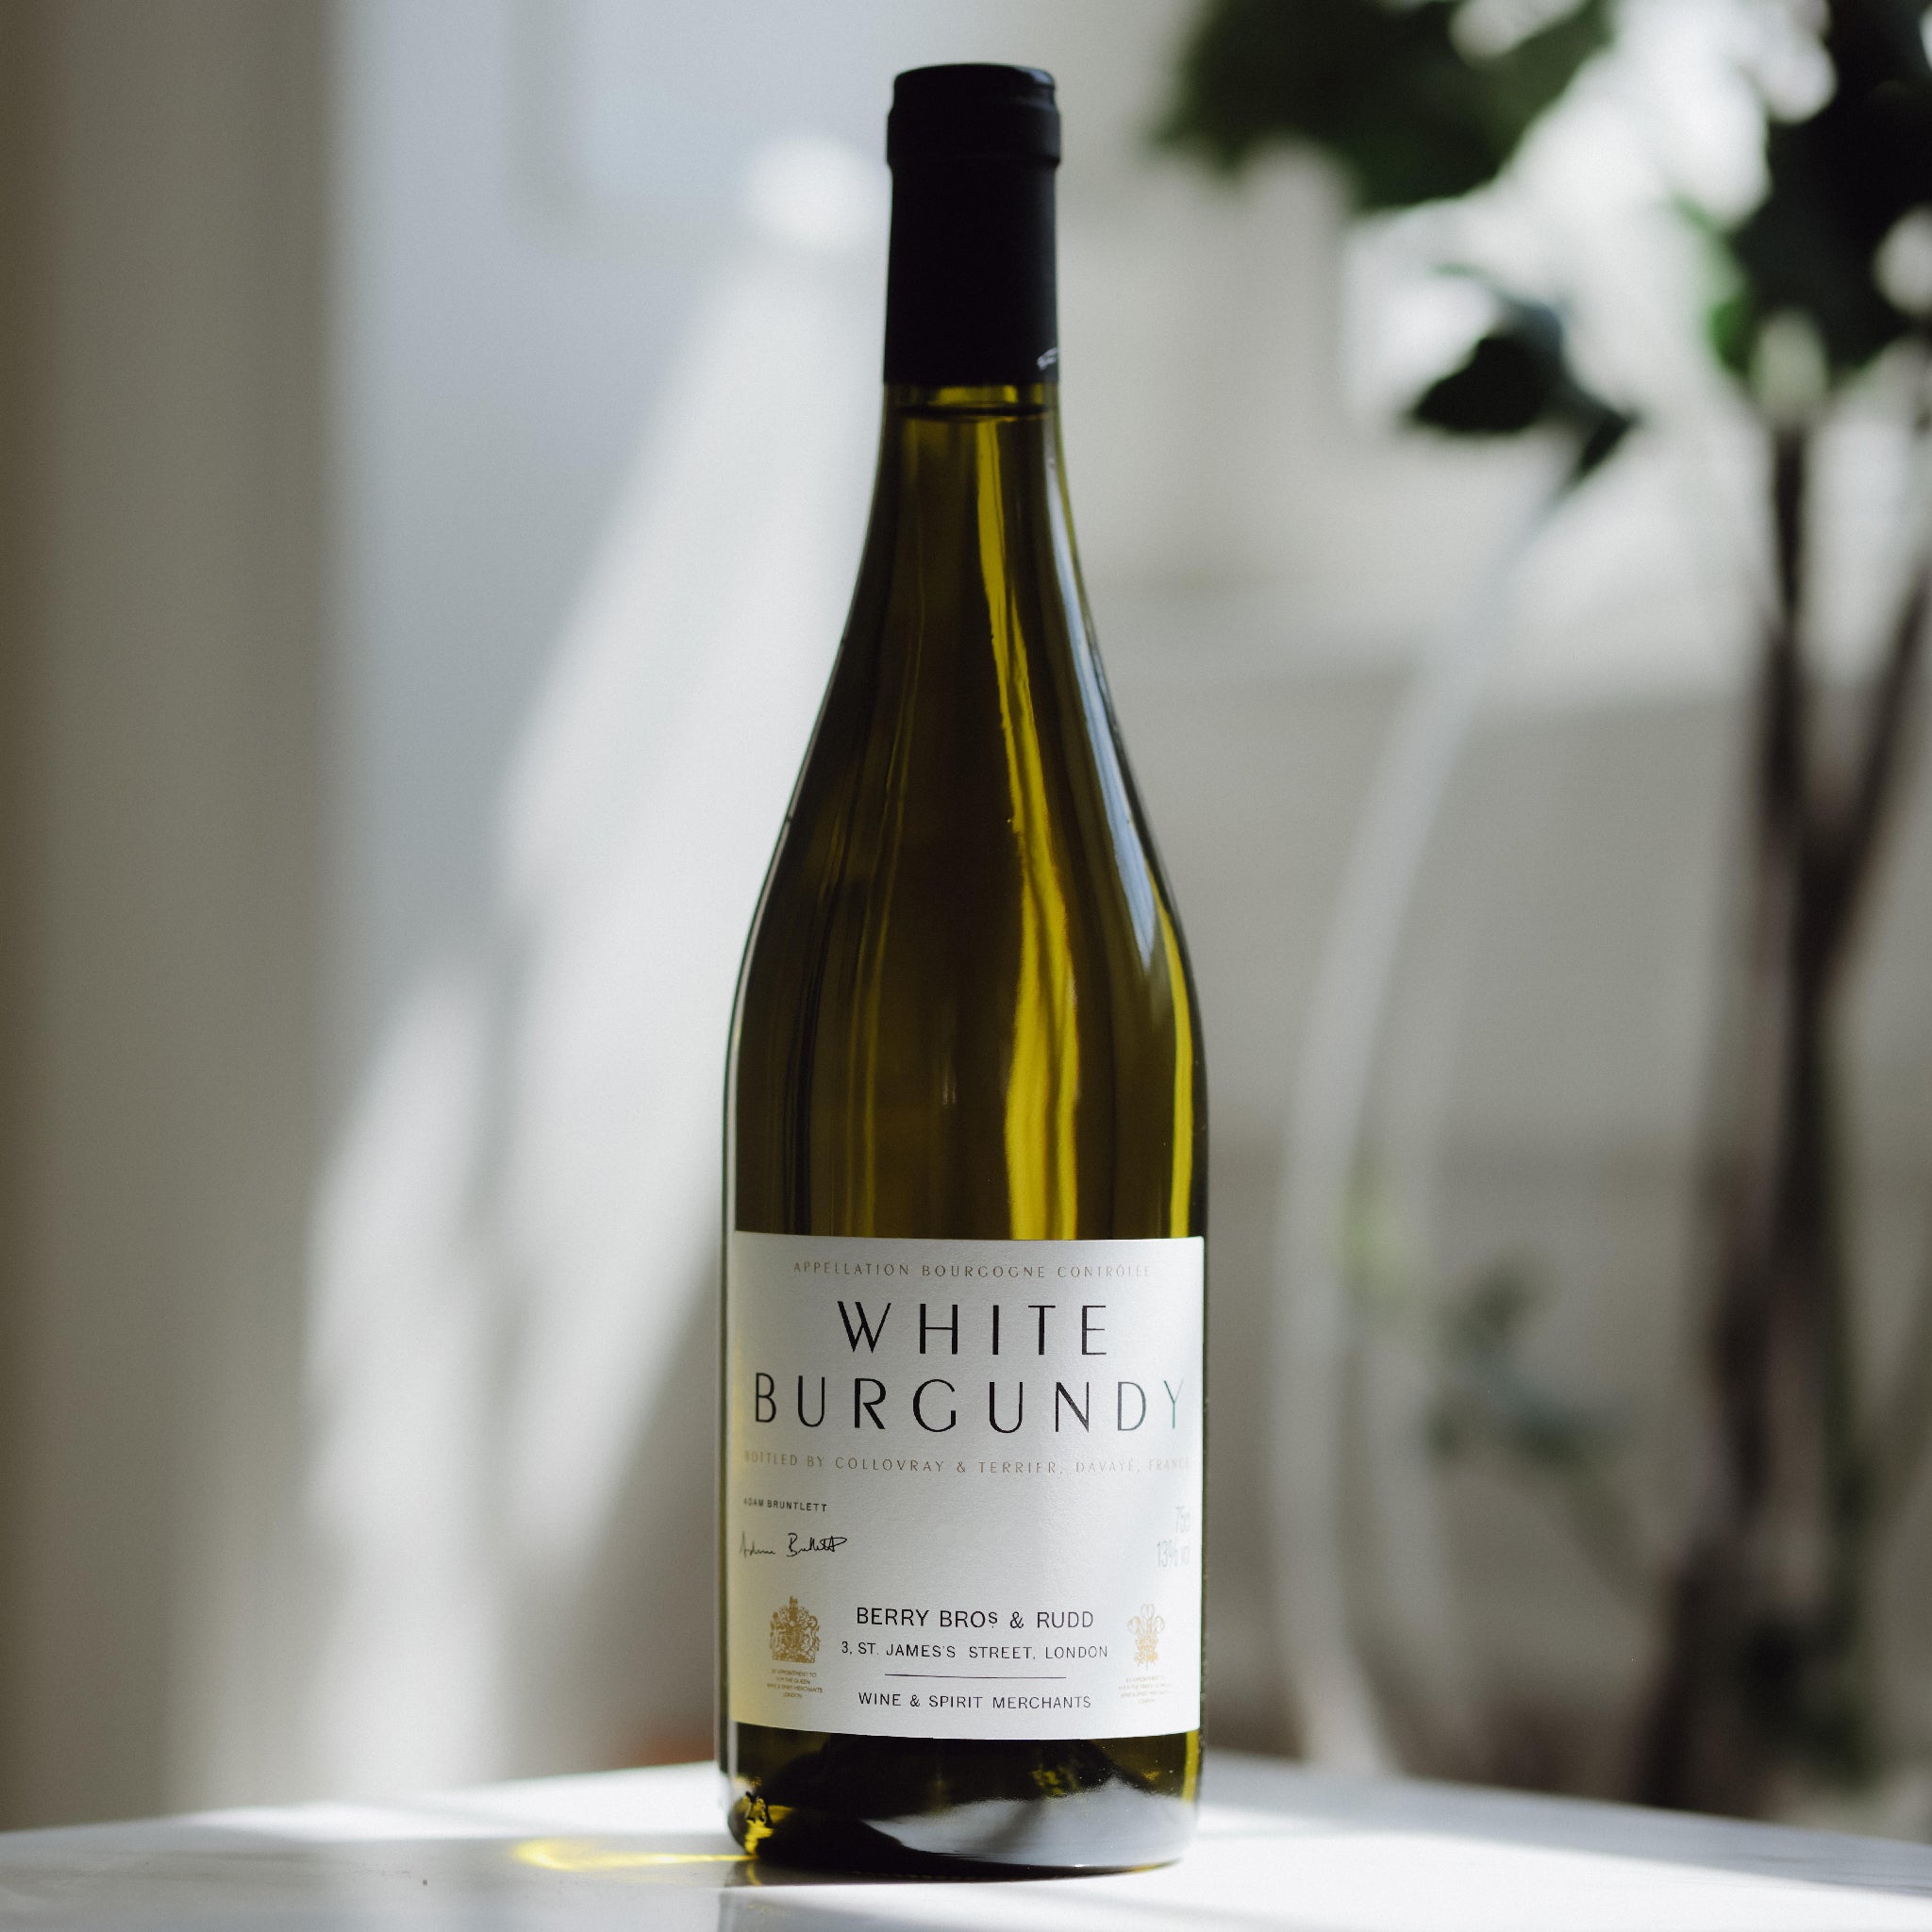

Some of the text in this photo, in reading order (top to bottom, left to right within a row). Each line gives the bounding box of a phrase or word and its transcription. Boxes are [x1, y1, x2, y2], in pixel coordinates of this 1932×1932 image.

[794, 1261, 909, 1276] APPELLATION
[922, 1265, 1045, 1278] BOURGOGNE
[837, 1300, 1108, 1356] WHITE
[755, 1372, 1184, 1434] BURGUNDY
[807, 1456, 825, 1467] BY
[835, 1457, 943, 1473] COLLOVRAY
[957, 1461, 966, 1473] &
[767, 1499, 827, 1512] BRUNTLETT
[857, 1607, 929, 1627] BERRY
[1009, 1611, 1024, 1629] &
[1037, 1610, 1094, 1629] RUDD
[1045, 1645, 1108, 1659] LONDON
[858, 1691, 1091, 1709] WINE & SPIRIT MERCHANTS
